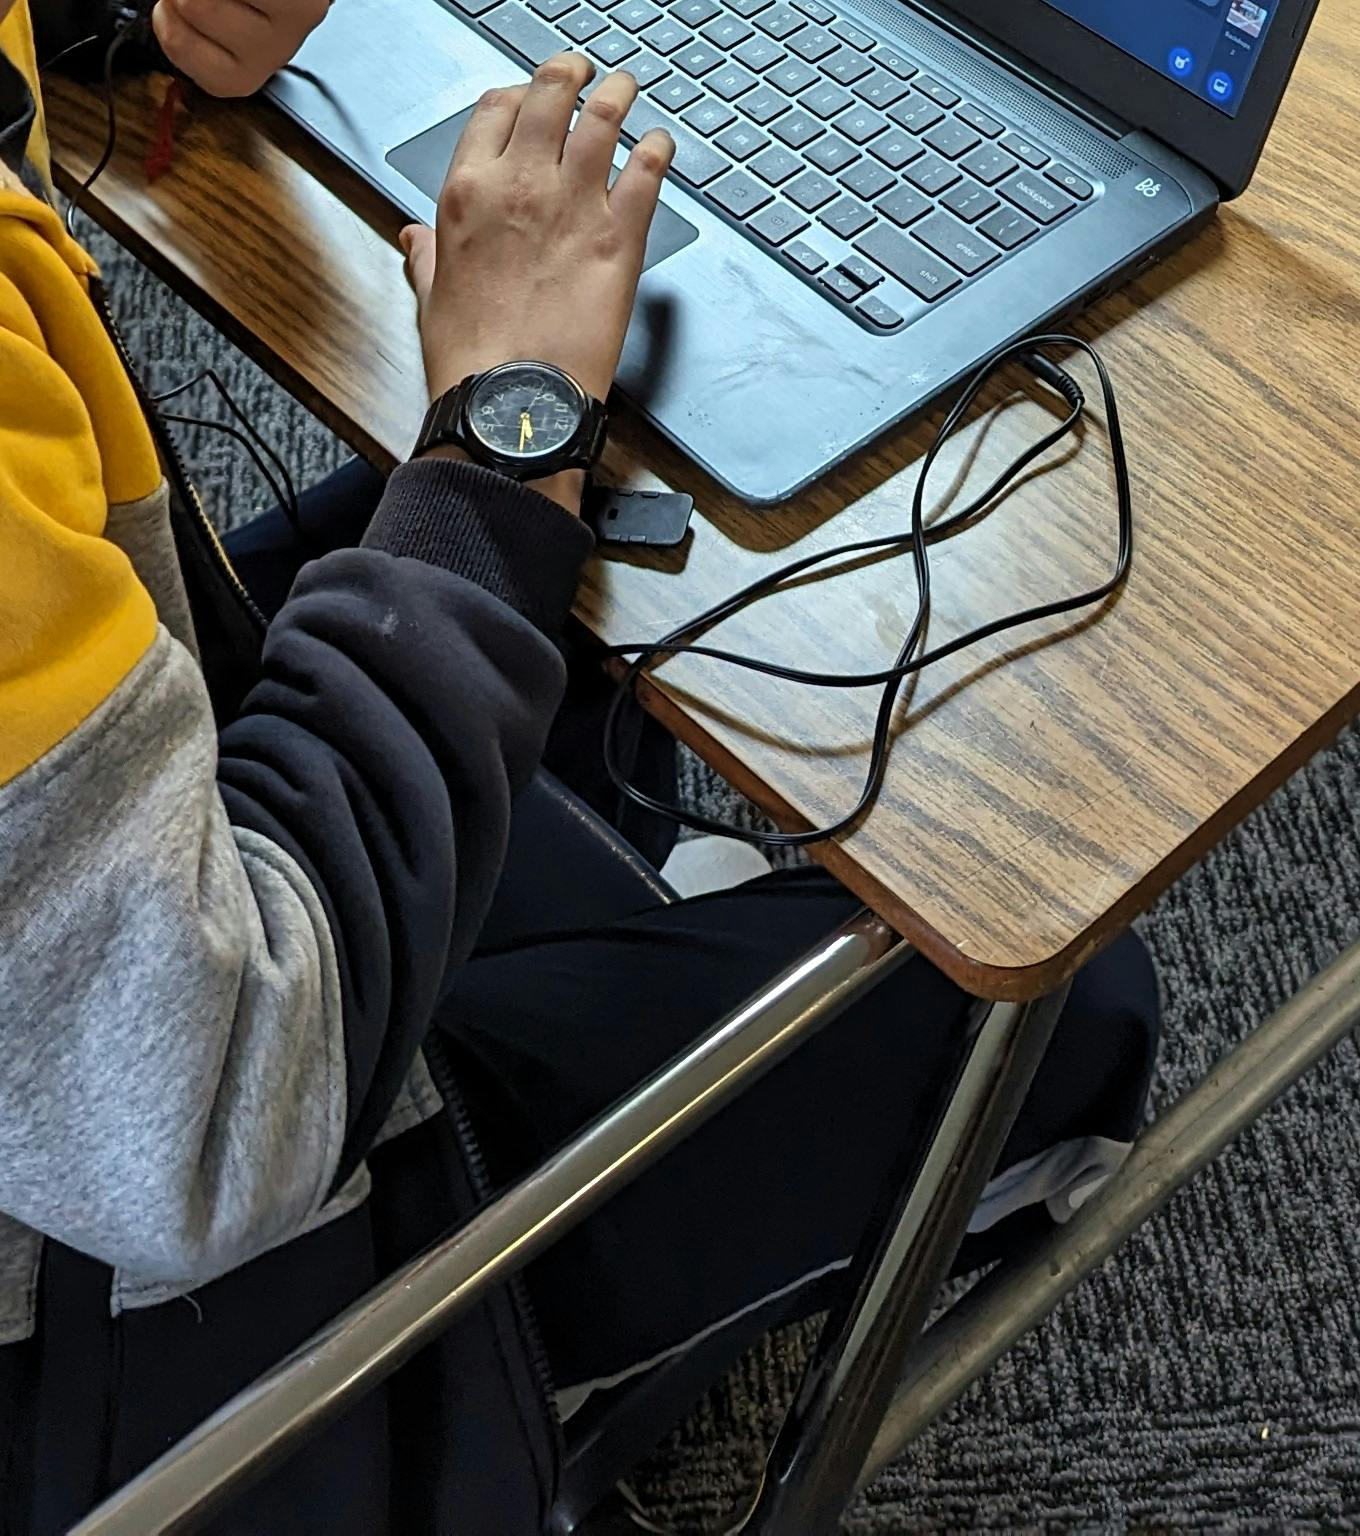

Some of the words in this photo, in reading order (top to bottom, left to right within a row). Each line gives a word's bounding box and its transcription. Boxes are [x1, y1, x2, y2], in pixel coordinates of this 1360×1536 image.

[1015, 181, 1055, 210] backspace
[955, 242, 980, 258] enter
[919, 267, 938, 284] shift
